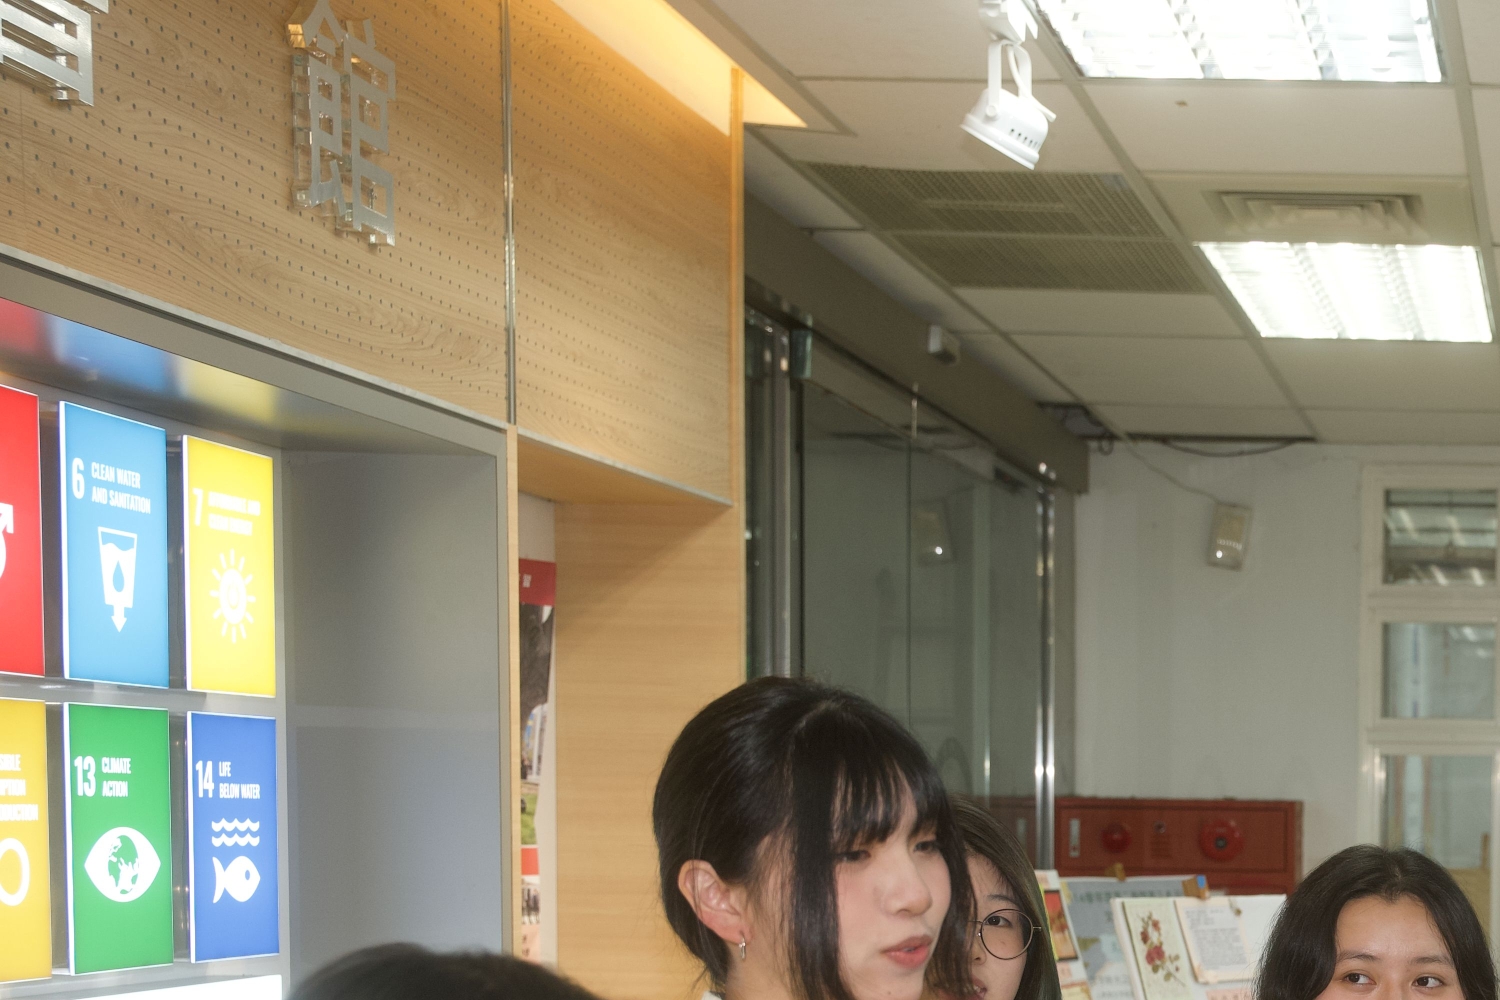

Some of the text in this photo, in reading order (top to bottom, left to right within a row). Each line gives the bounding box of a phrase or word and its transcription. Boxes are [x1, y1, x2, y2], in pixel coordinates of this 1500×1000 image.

[72, 457, 85, 499] 6
[91, 461, 141, 489] CLEAN WATER
[92, 486, 151, 514] AND SANITATION
[192, 487, 203, 526] 7
[74, 755, 96, 797] 13
[101, 756, 132, 774] CLIMATE
[195, 760, 215, 798] 14
[218, 761, 232, 777] LIFE
[102, 780, 128, 797] ACTION
[218, 783, 261, 800] BELOW WATER
